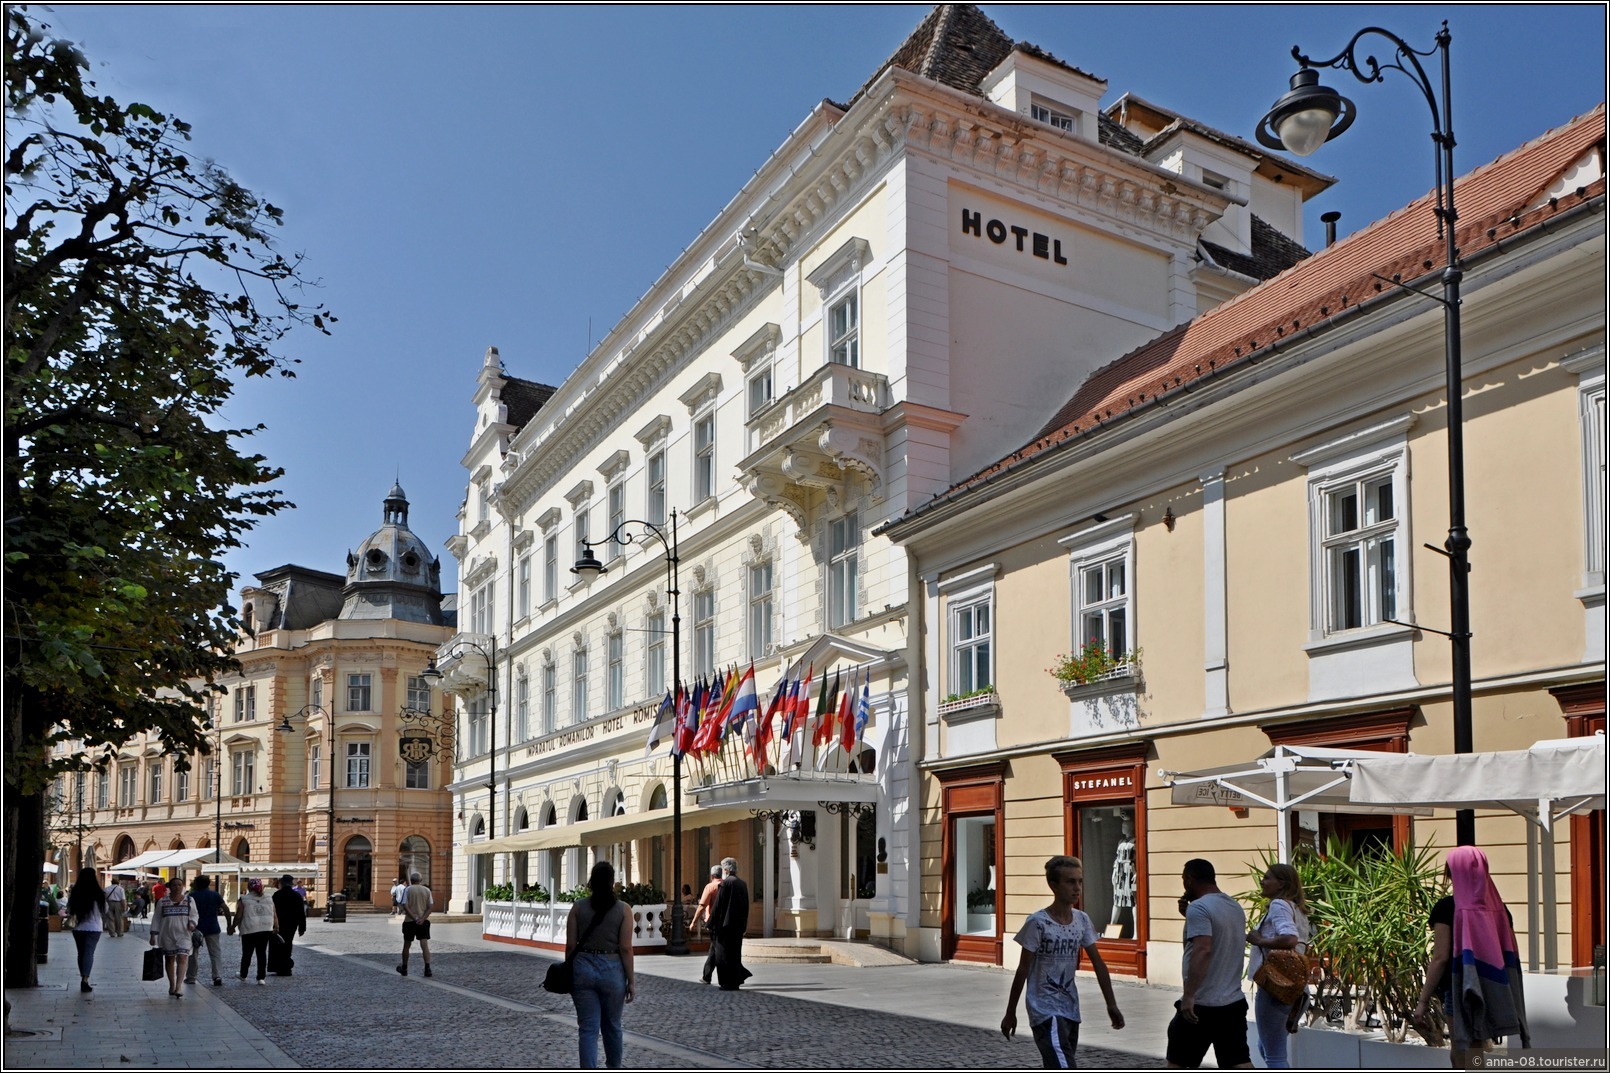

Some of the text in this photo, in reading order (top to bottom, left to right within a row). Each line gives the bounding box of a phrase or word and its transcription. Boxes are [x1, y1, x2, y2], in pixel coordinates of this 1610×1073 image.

[962, 208, 1067, 266] HOTEL
[602, 716, 624, 735] HOTEL
[1074, 776, 1133, 790] STEFANEL
